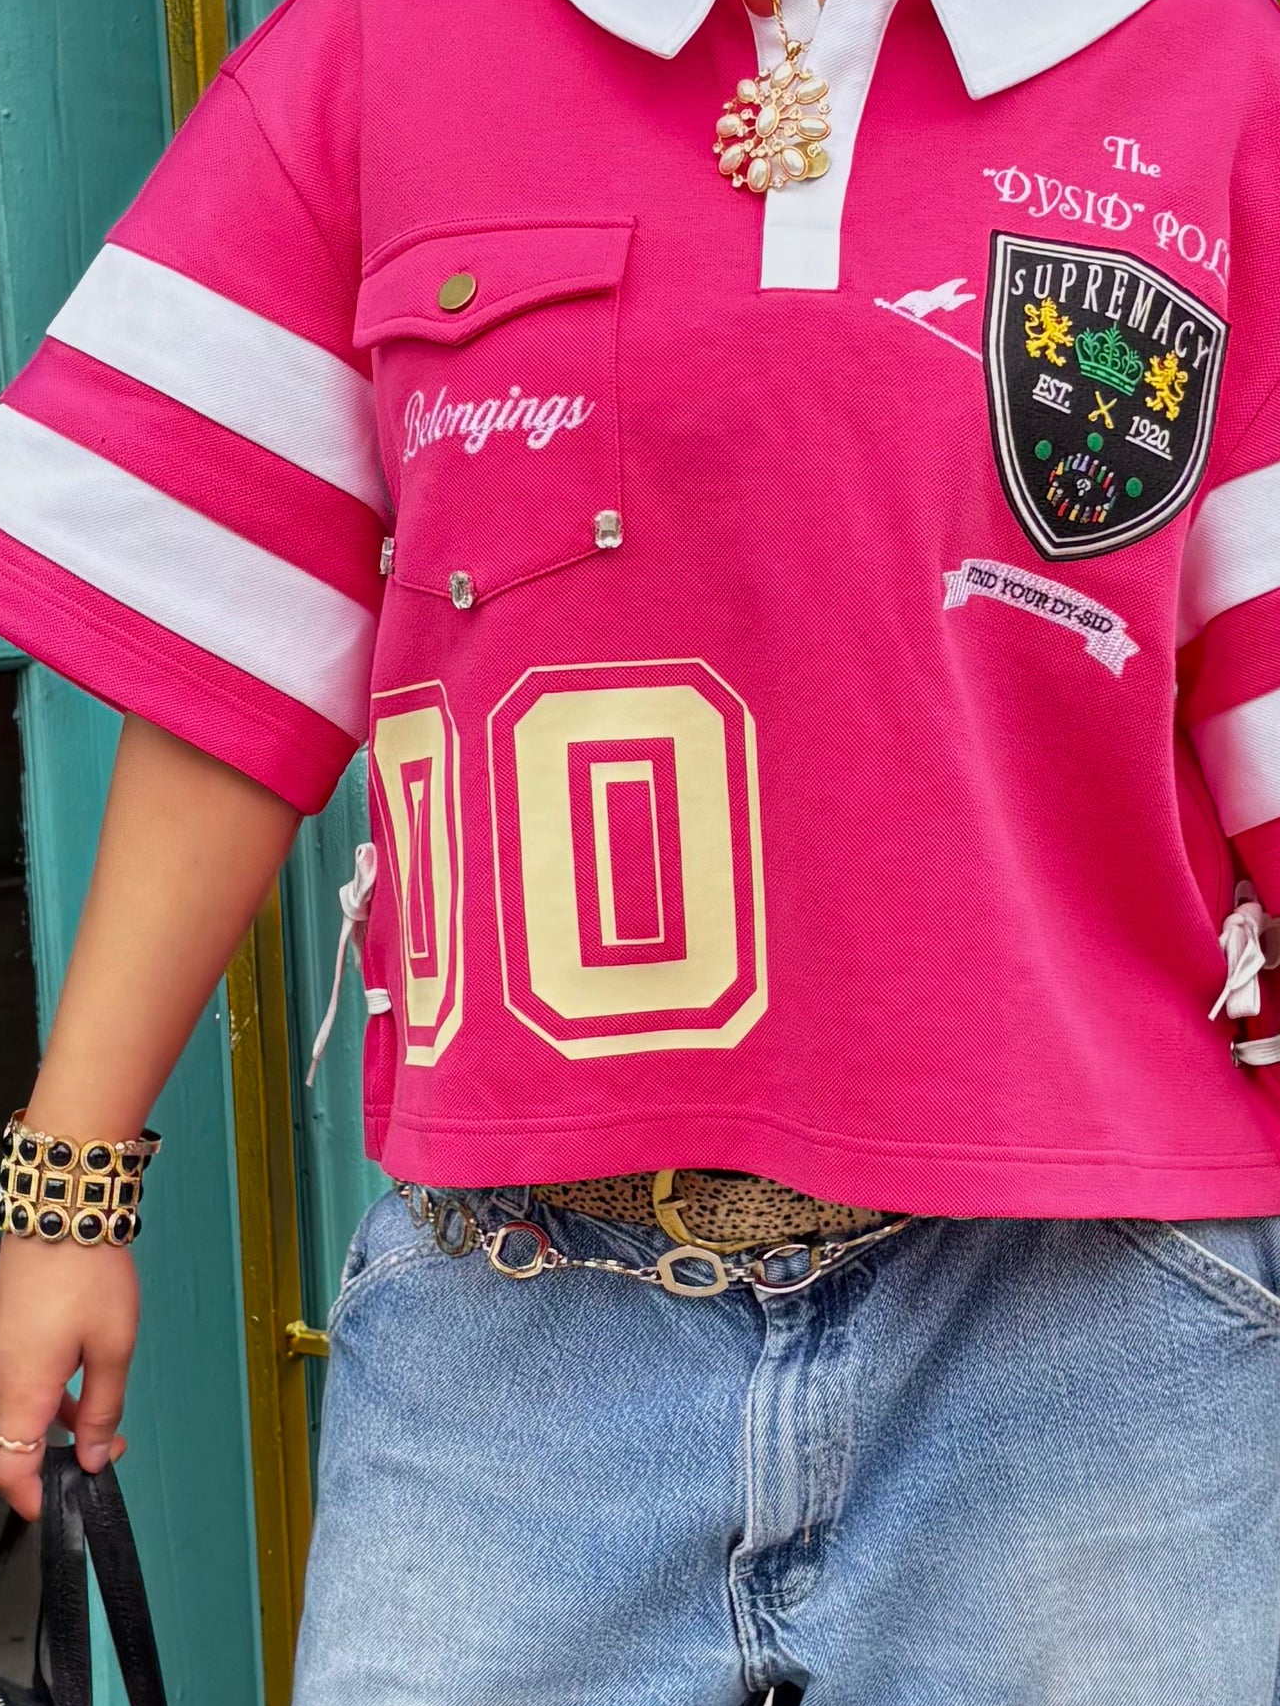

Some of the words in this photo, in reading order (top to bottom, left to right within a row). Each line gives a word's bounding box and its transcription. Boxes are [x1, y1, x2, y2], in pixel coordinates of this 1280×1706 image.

[1103, 136, 1162, 177] The
[1152, 210, 1230, 291] POL
[1011, 263, 1210, 369] SUPREMACY
[1032, 374, 1073, 408] EST.
[404, 386, 595, 462] Belongings
[1128, 415, 1172, 453] 1920.
[966, 567, 997, 589] FIND
[1002, 577, 1048, 610] YOUR
